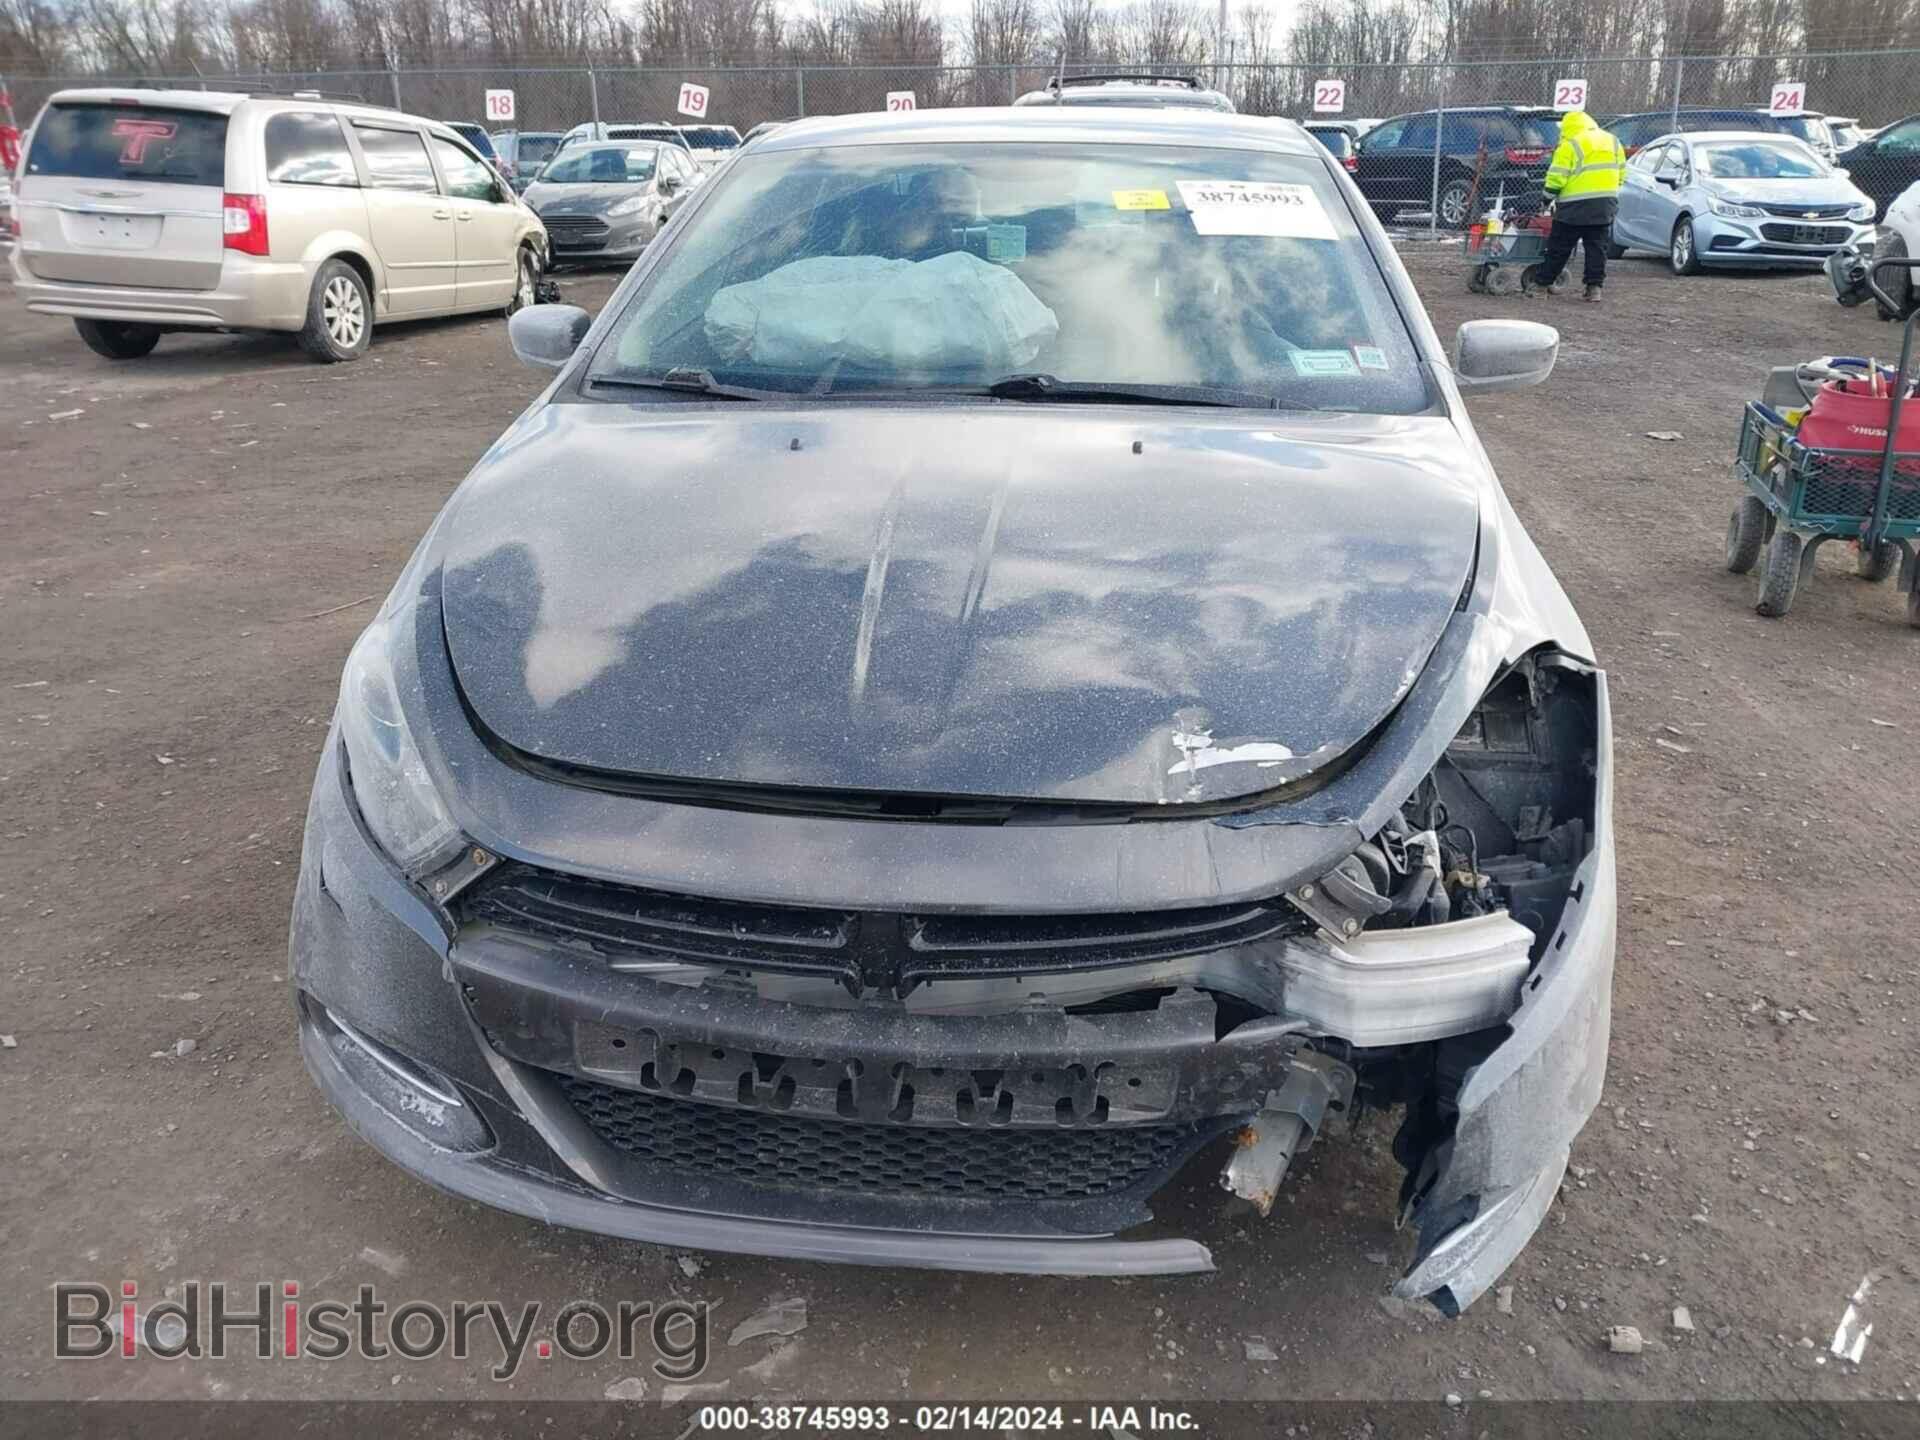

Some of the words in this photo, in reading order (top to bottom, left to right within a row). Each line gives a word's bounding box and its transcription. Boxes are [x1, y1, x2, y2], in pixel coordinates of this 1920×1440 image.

[488, 95, 512, 115] 18
[682, 89, 705, 112] 19
[890, 98, 913, 111] 20
[1316, 87, 1341, 106] 22
[1556, 86, 1583, 105] 23
[1773, 91, 1800, 110] 24
[1196, 190, 1304, 206] 38745993
